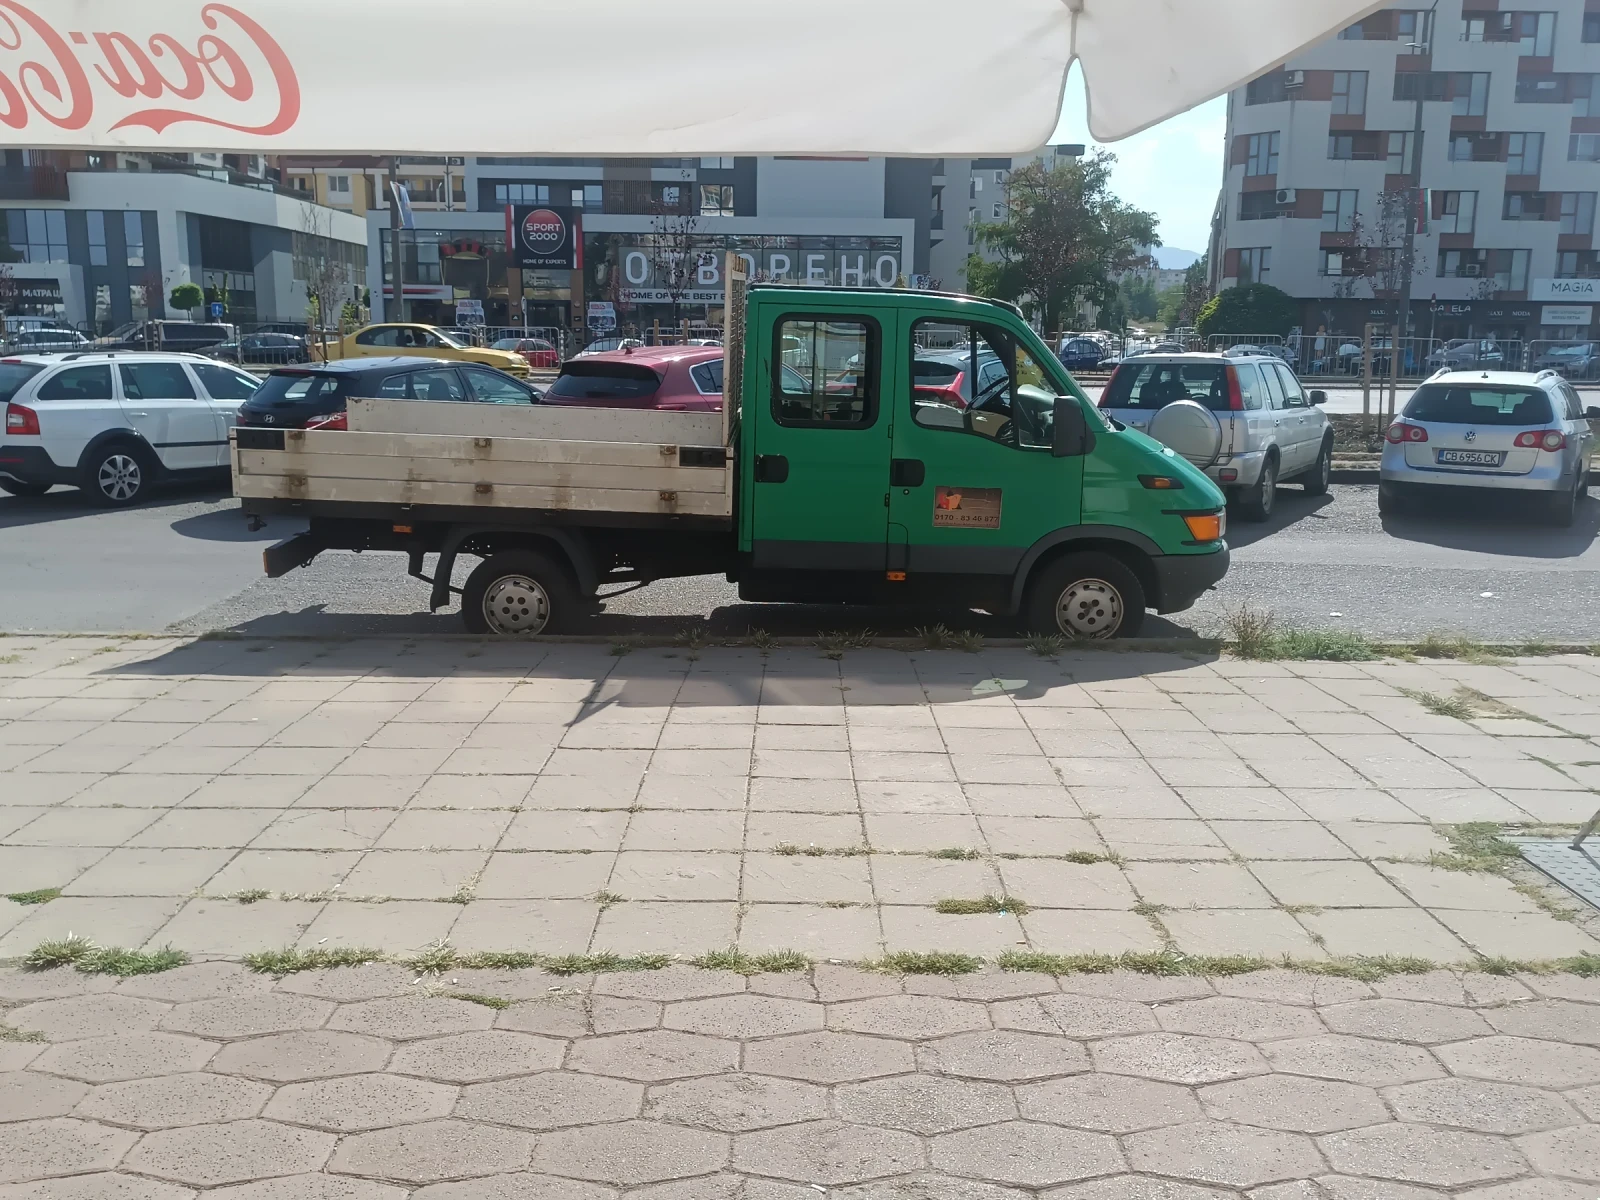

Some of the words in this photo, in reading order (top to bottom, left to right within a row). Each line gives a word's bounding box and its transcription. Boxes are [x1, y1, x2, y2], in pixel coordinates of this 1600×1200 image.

[526, 223, 560, 231] SPORT
[1445, 452, 1457, 461] CB
[1459, 453, 1482, 462] 6956
[1484, 454, 1497, 463] CK
